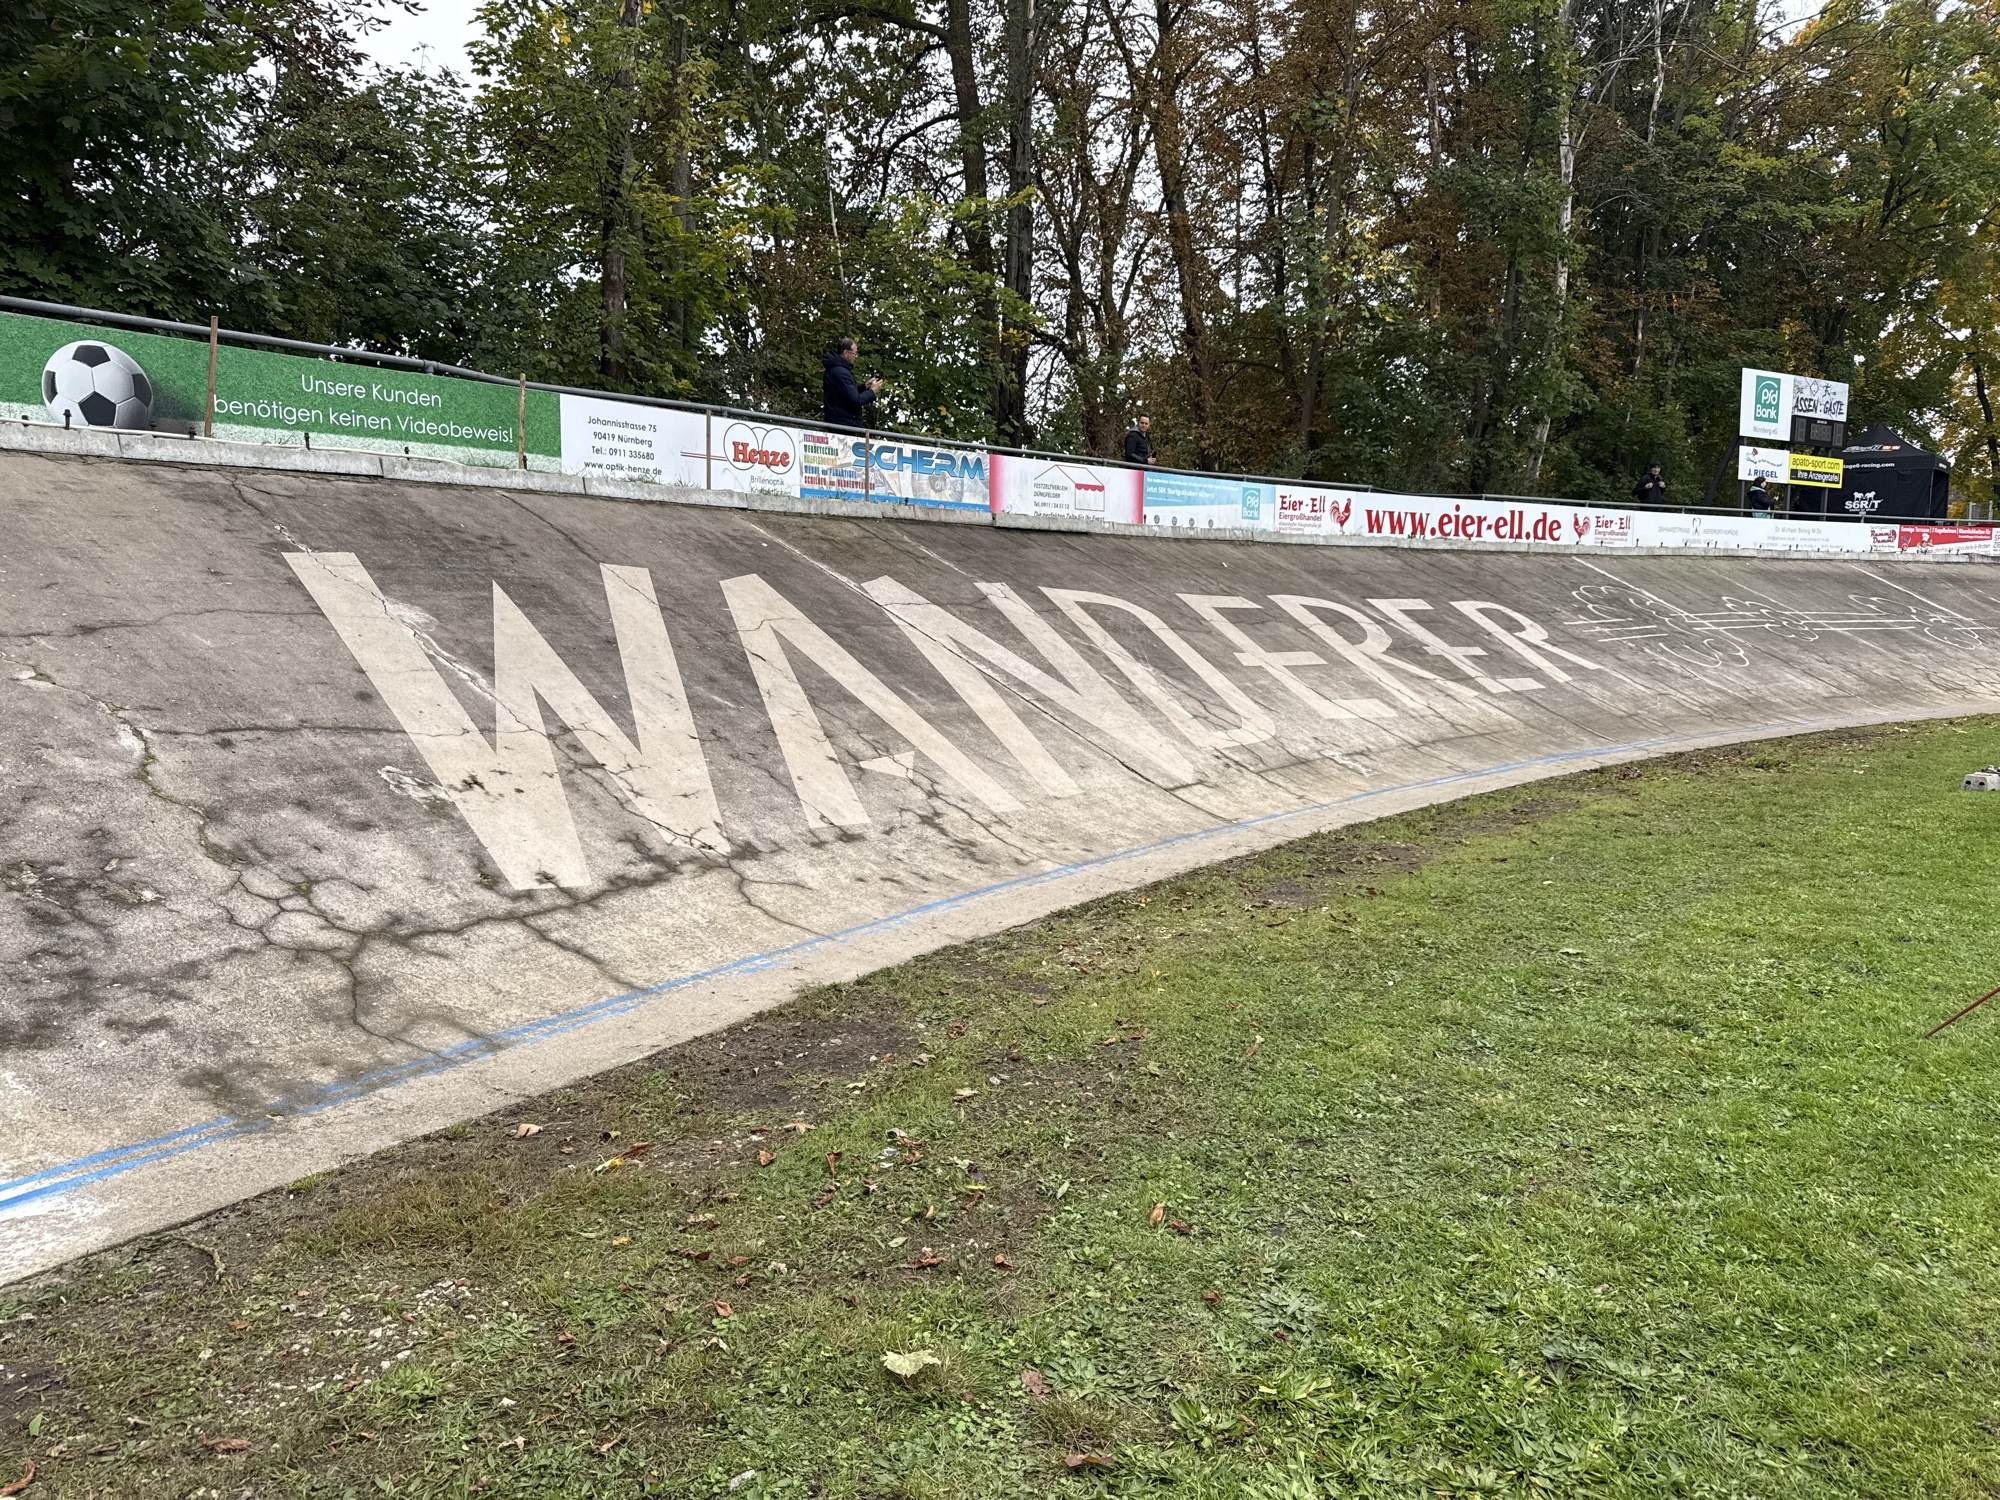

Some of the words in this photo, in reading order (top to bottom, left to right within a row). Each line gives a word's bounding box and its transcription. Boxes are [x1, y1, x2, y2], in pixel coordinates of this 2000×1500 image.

[301, 373, 366, 399] Unsere
[372, 383, 442, 408] Kunden
[213, 394, 323, 425] benötigen
[329, 407, 391, 431] keinen
[396, 414, 513, 443] Videobeweis!
[1755, 404, 1777, 420] Bank
[587, 415, 647, 432] Johannisstrasse
[648, 423, 657, 433] 75
[593, 431, 616, 443] 90419
[617, 434, 653, 448] Nürnberg
[592, 445, 607, 455] Tel.:
[608, 447, 626, 458] 0911
[628, 449, 655, 461] 335680
[732, 440, 790, 468] Henze
[852, 440, 985, 481] SCHERM
[584, 460, 663, 476] www.optik-henze.de
[1753, 468, 1779, 479] RIEGEL
[1279, 494, 1304, 511] Eier
[1310, 495, 1326, 513] Ell
[1278, 511, 1322, 521] Eiergroßhandel
[1365, 504, 1562, 542] www.eier-ell.de
[1595, 514, 1614, 529] Eier
[1618, 514, 1631, 530] Ell
[282, 550, 1602, 891] WANDERER
